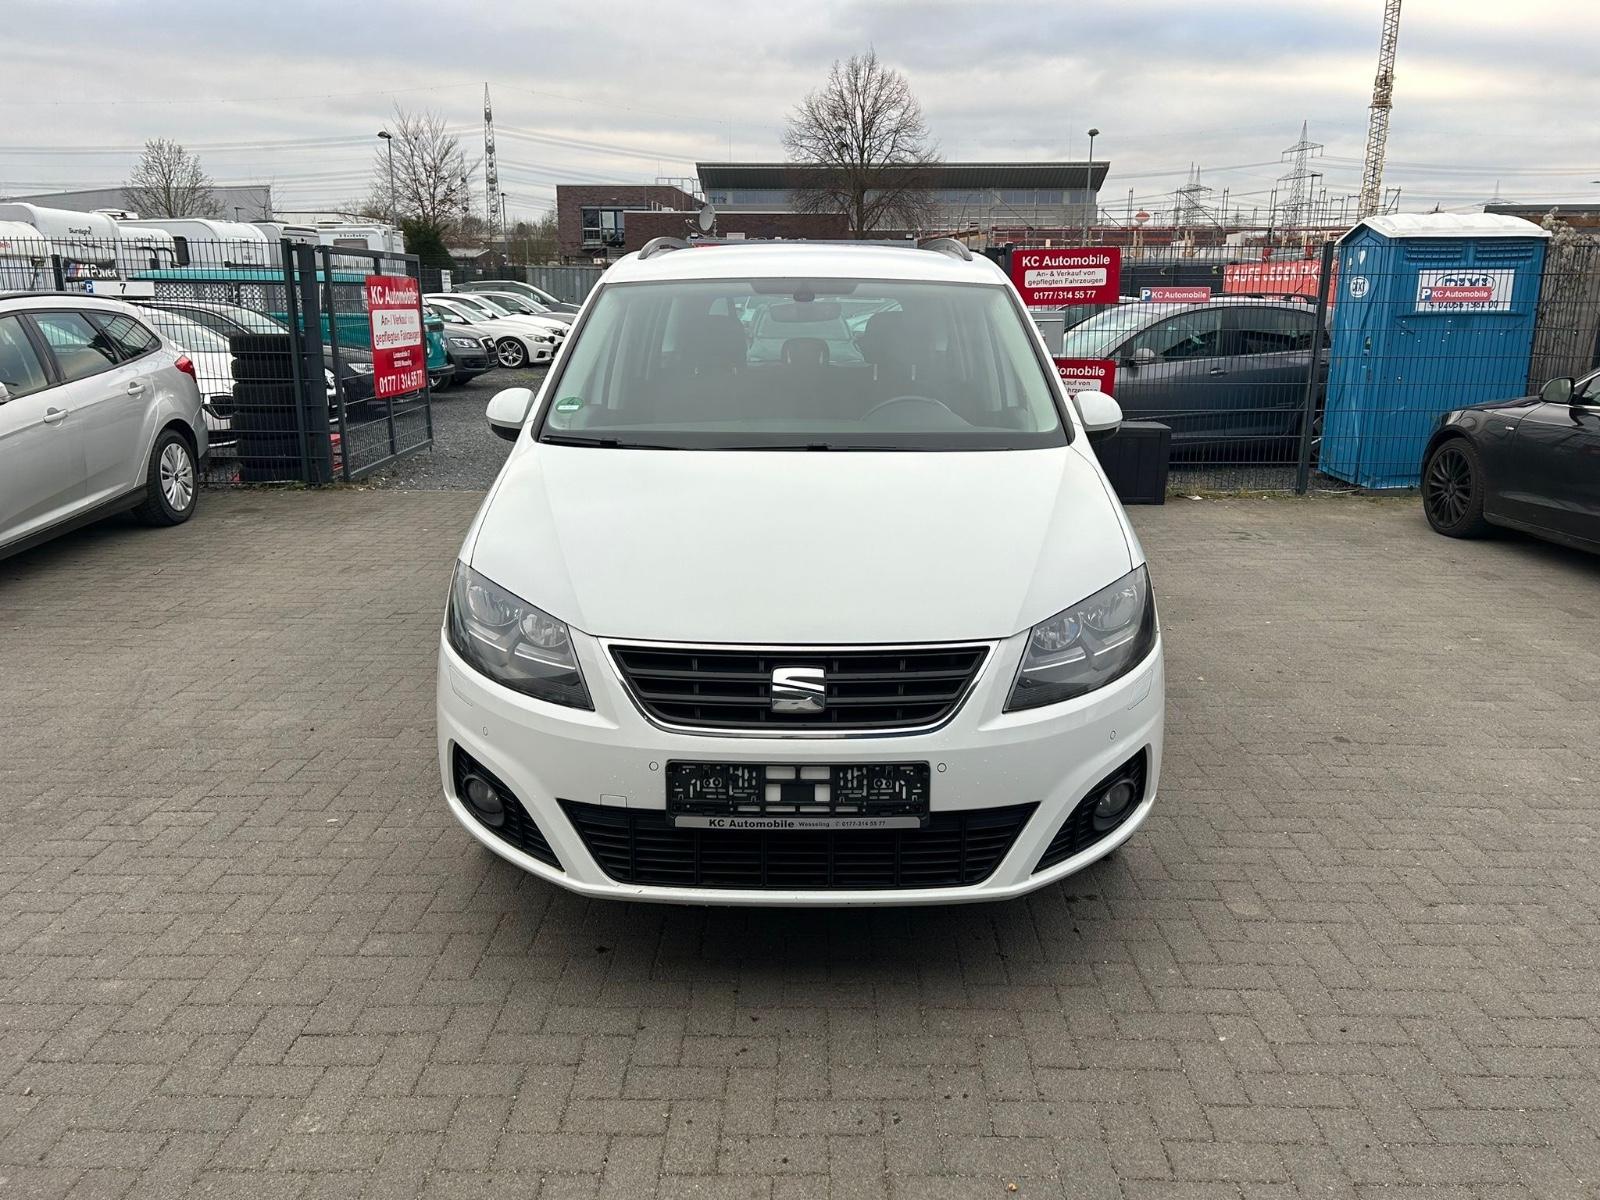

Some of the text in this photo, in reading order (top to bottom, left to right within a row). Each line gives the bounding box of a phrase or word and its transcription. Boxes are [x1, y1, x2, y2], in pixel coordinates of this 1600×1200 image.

[1022, 254, 1110, 267] KC Automobile
[1028, 278, 1063, 286] gepflegten
[119, 283, 126, 294] 7
[371, 286, 384, 305] KC
[1086, 290, 1096, 298] 77
[1151, 291, 1163, 299] KC
[1164, 290, 1207, 299] Automobile
[1431, 290, 1443, 298] KC
[1444, 290, 1489, 298] Automobile
[708, 819, 725, 828] KC
[728, 818, 795, 829] Automobile
[798, 820, 830, 828] Wesseling
